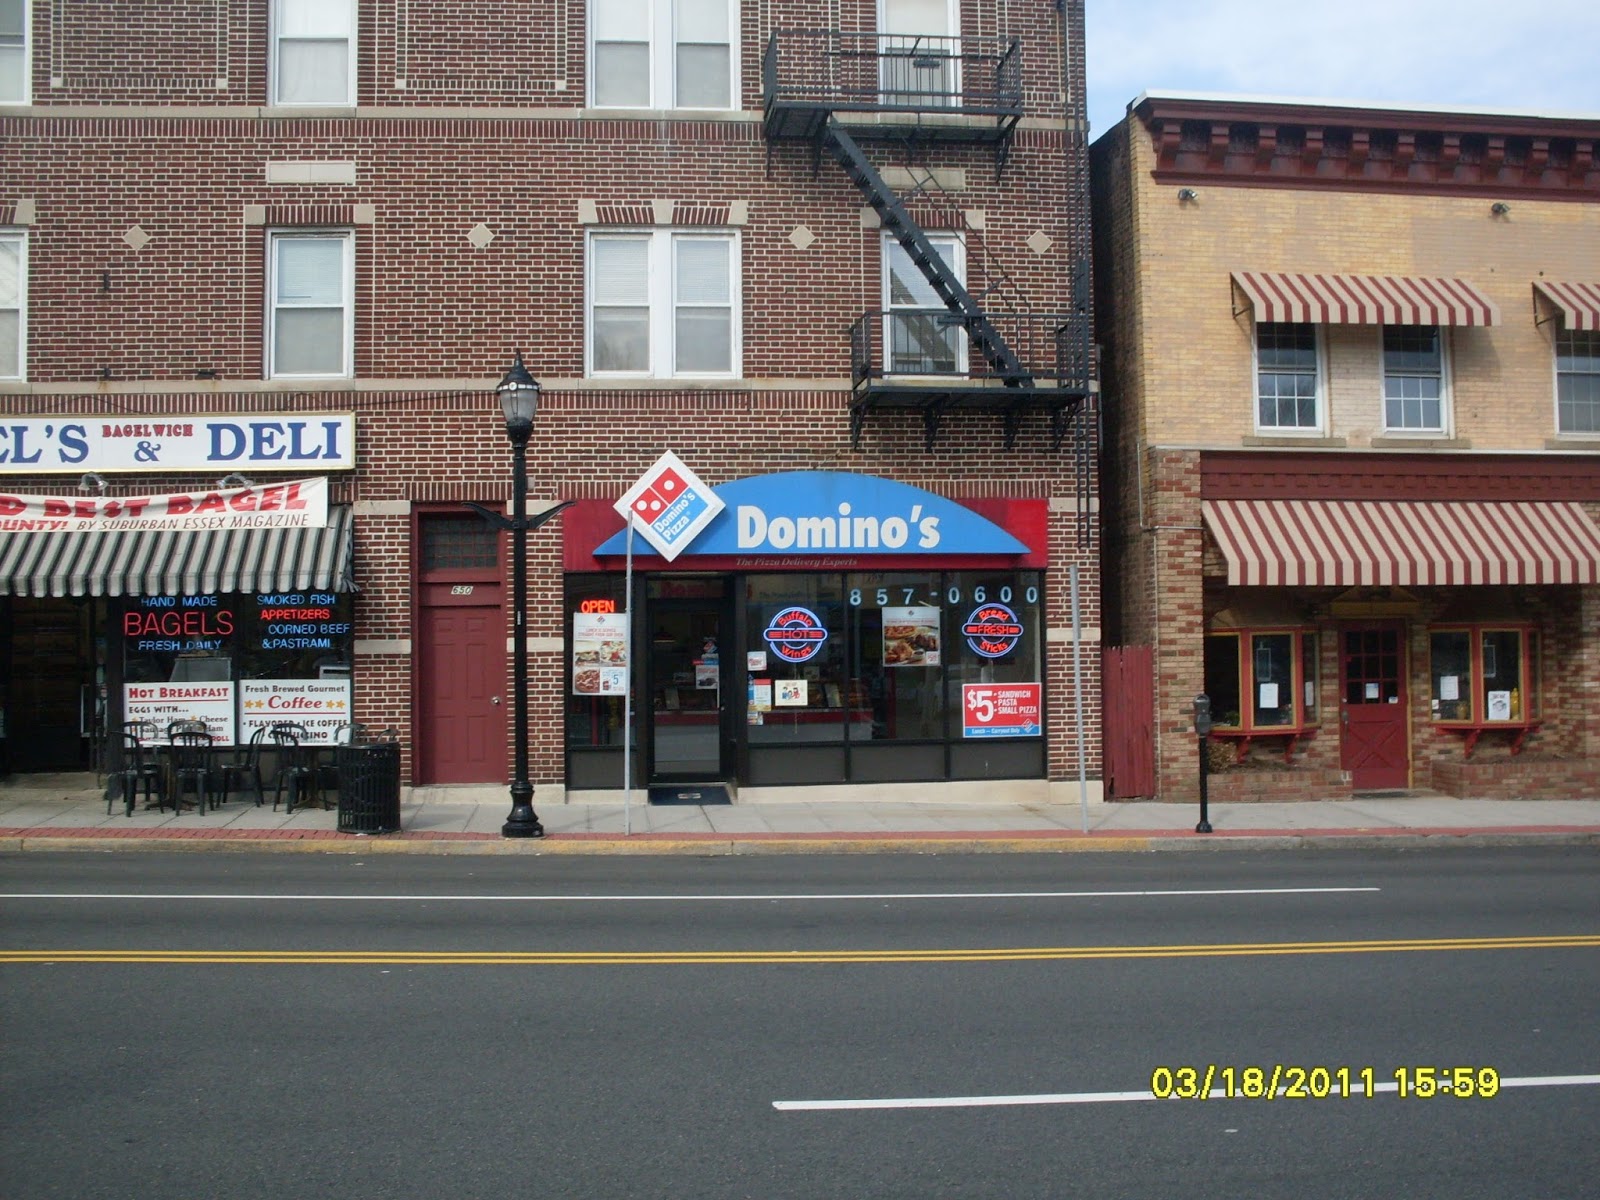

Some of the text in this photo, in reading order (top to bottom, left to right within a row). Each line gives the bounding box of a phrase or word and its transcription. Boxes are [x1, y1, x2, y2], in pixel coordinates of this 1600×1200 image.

[0, 421, 342, 464] L'S & DELI
[43, 499, 150, 518] BEST
[166, 483, 308, 515] BAGEL
[654, 493, 695, 532] Domino's
[0, 514, 309, 530] UNTY! BY SUBURBAN ESSEX MAGAZINE
[737, 502, 940, 548] Domino's
[662, 516, 690, 541] Pizza
[736, 557, 857, 567] The Pizza Delivery Experts
[453, 586, 472, 594] 650
[141, 596, 217, 607] HAND MADE
[257, 594, 335, 605] SMOKED FISH
[581, 600, 615, 613] OPEN
[261, 609, 330, 620] APPETIZERS
[778, 611, 813, 626] Buffalo
[979, 609, 1009, 621] Bread
[124, 611, 234, 636] BAGELS
[268, 623, 350, 634] CORNED BEEF
[782, 630, 808, 639] HOT
[977, 625, 1010, 635] FRESH
[138, 639, 222, 651] FRESH DAILY
[979, 641, 1008, 653] Sticks
[781, 645, 812, 658] Wings
[128, 687, 229, 698] HOT BREAKFAST
[246, 684, 345, 693] Fresh Brewed Gourmet
[998, 690, 1031, 699] SANDWICH
[268, 695, 322, 709] Coffee
[967, 689, 994, 723] $5
[998, 698, 1018, 706] PASTA
[128, 706, 151, 714] EGGS
[998, 706, 1037, 714] SMALL PIZZA
[199, 715, 228, 723] Cheese
[303, 719, 314, 727] ICE
[317, 719, 348, 727] COFFEE
